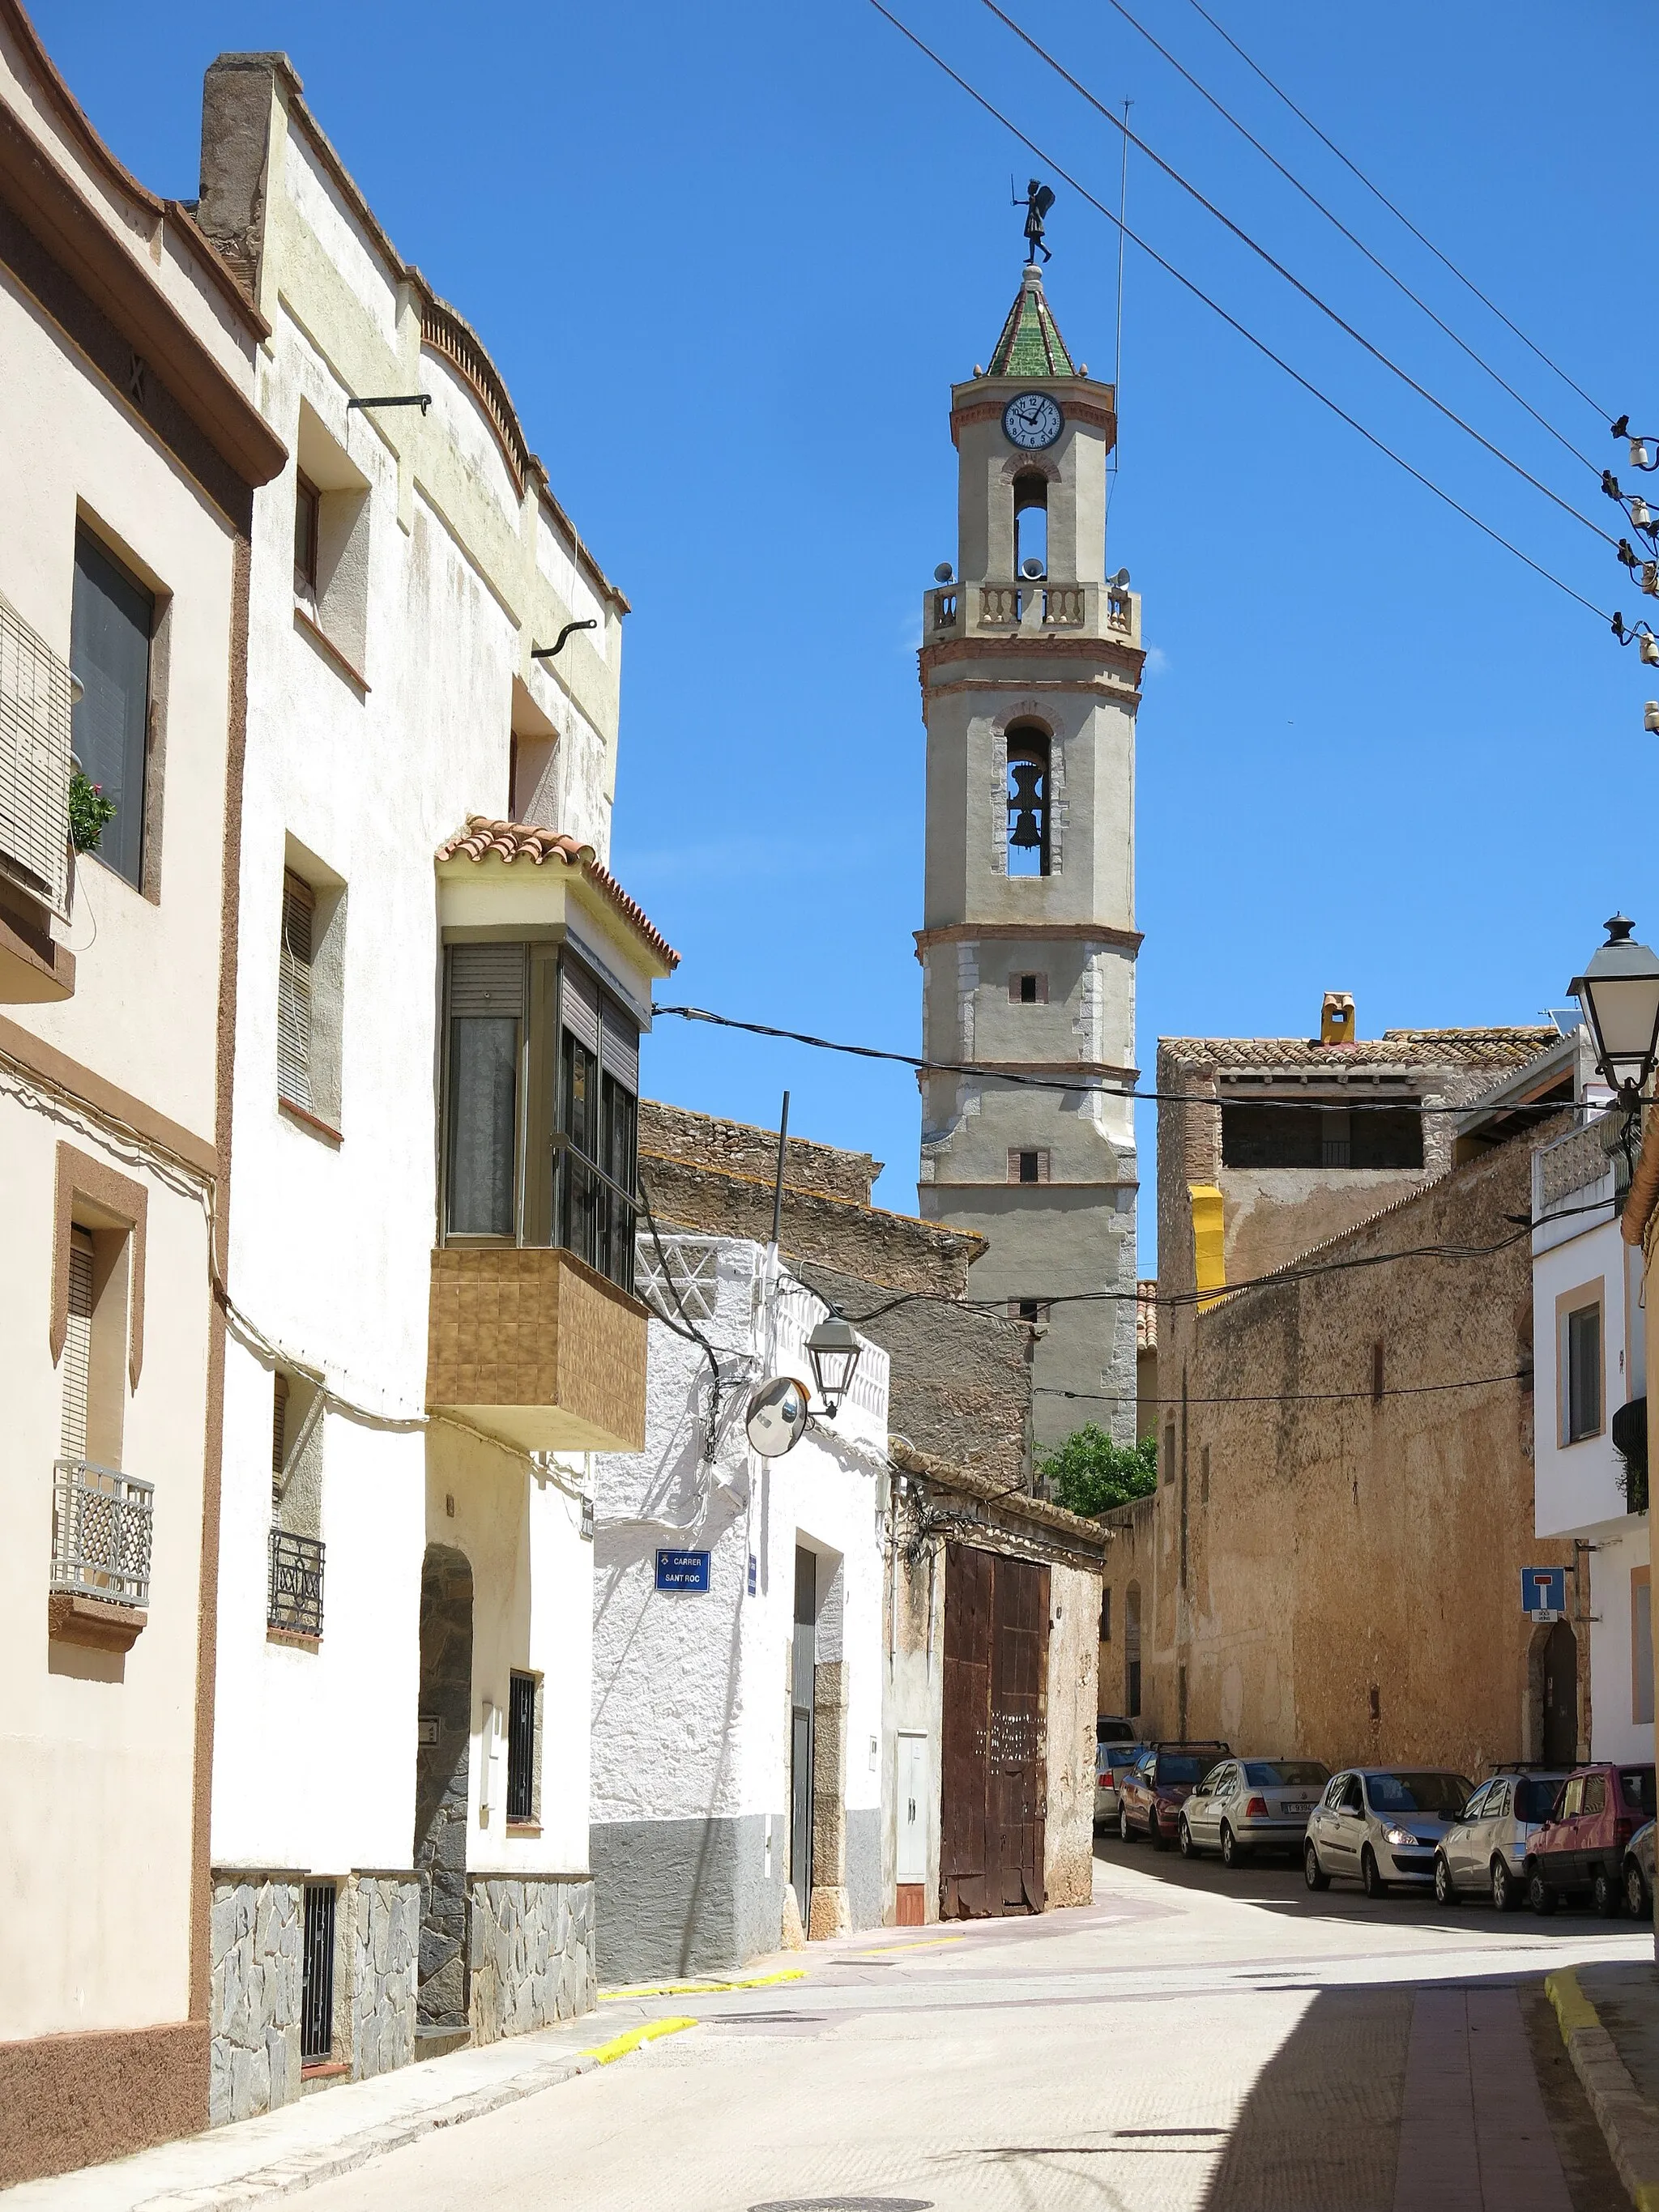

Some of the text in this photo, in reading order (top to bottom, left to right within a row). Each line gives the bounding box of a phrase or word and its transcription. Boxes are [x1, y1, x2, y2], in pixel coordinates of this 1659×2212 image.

[674, 1558, 702, 1566] CARRER
[665, 1574, 700, 1583] SANT ROC
